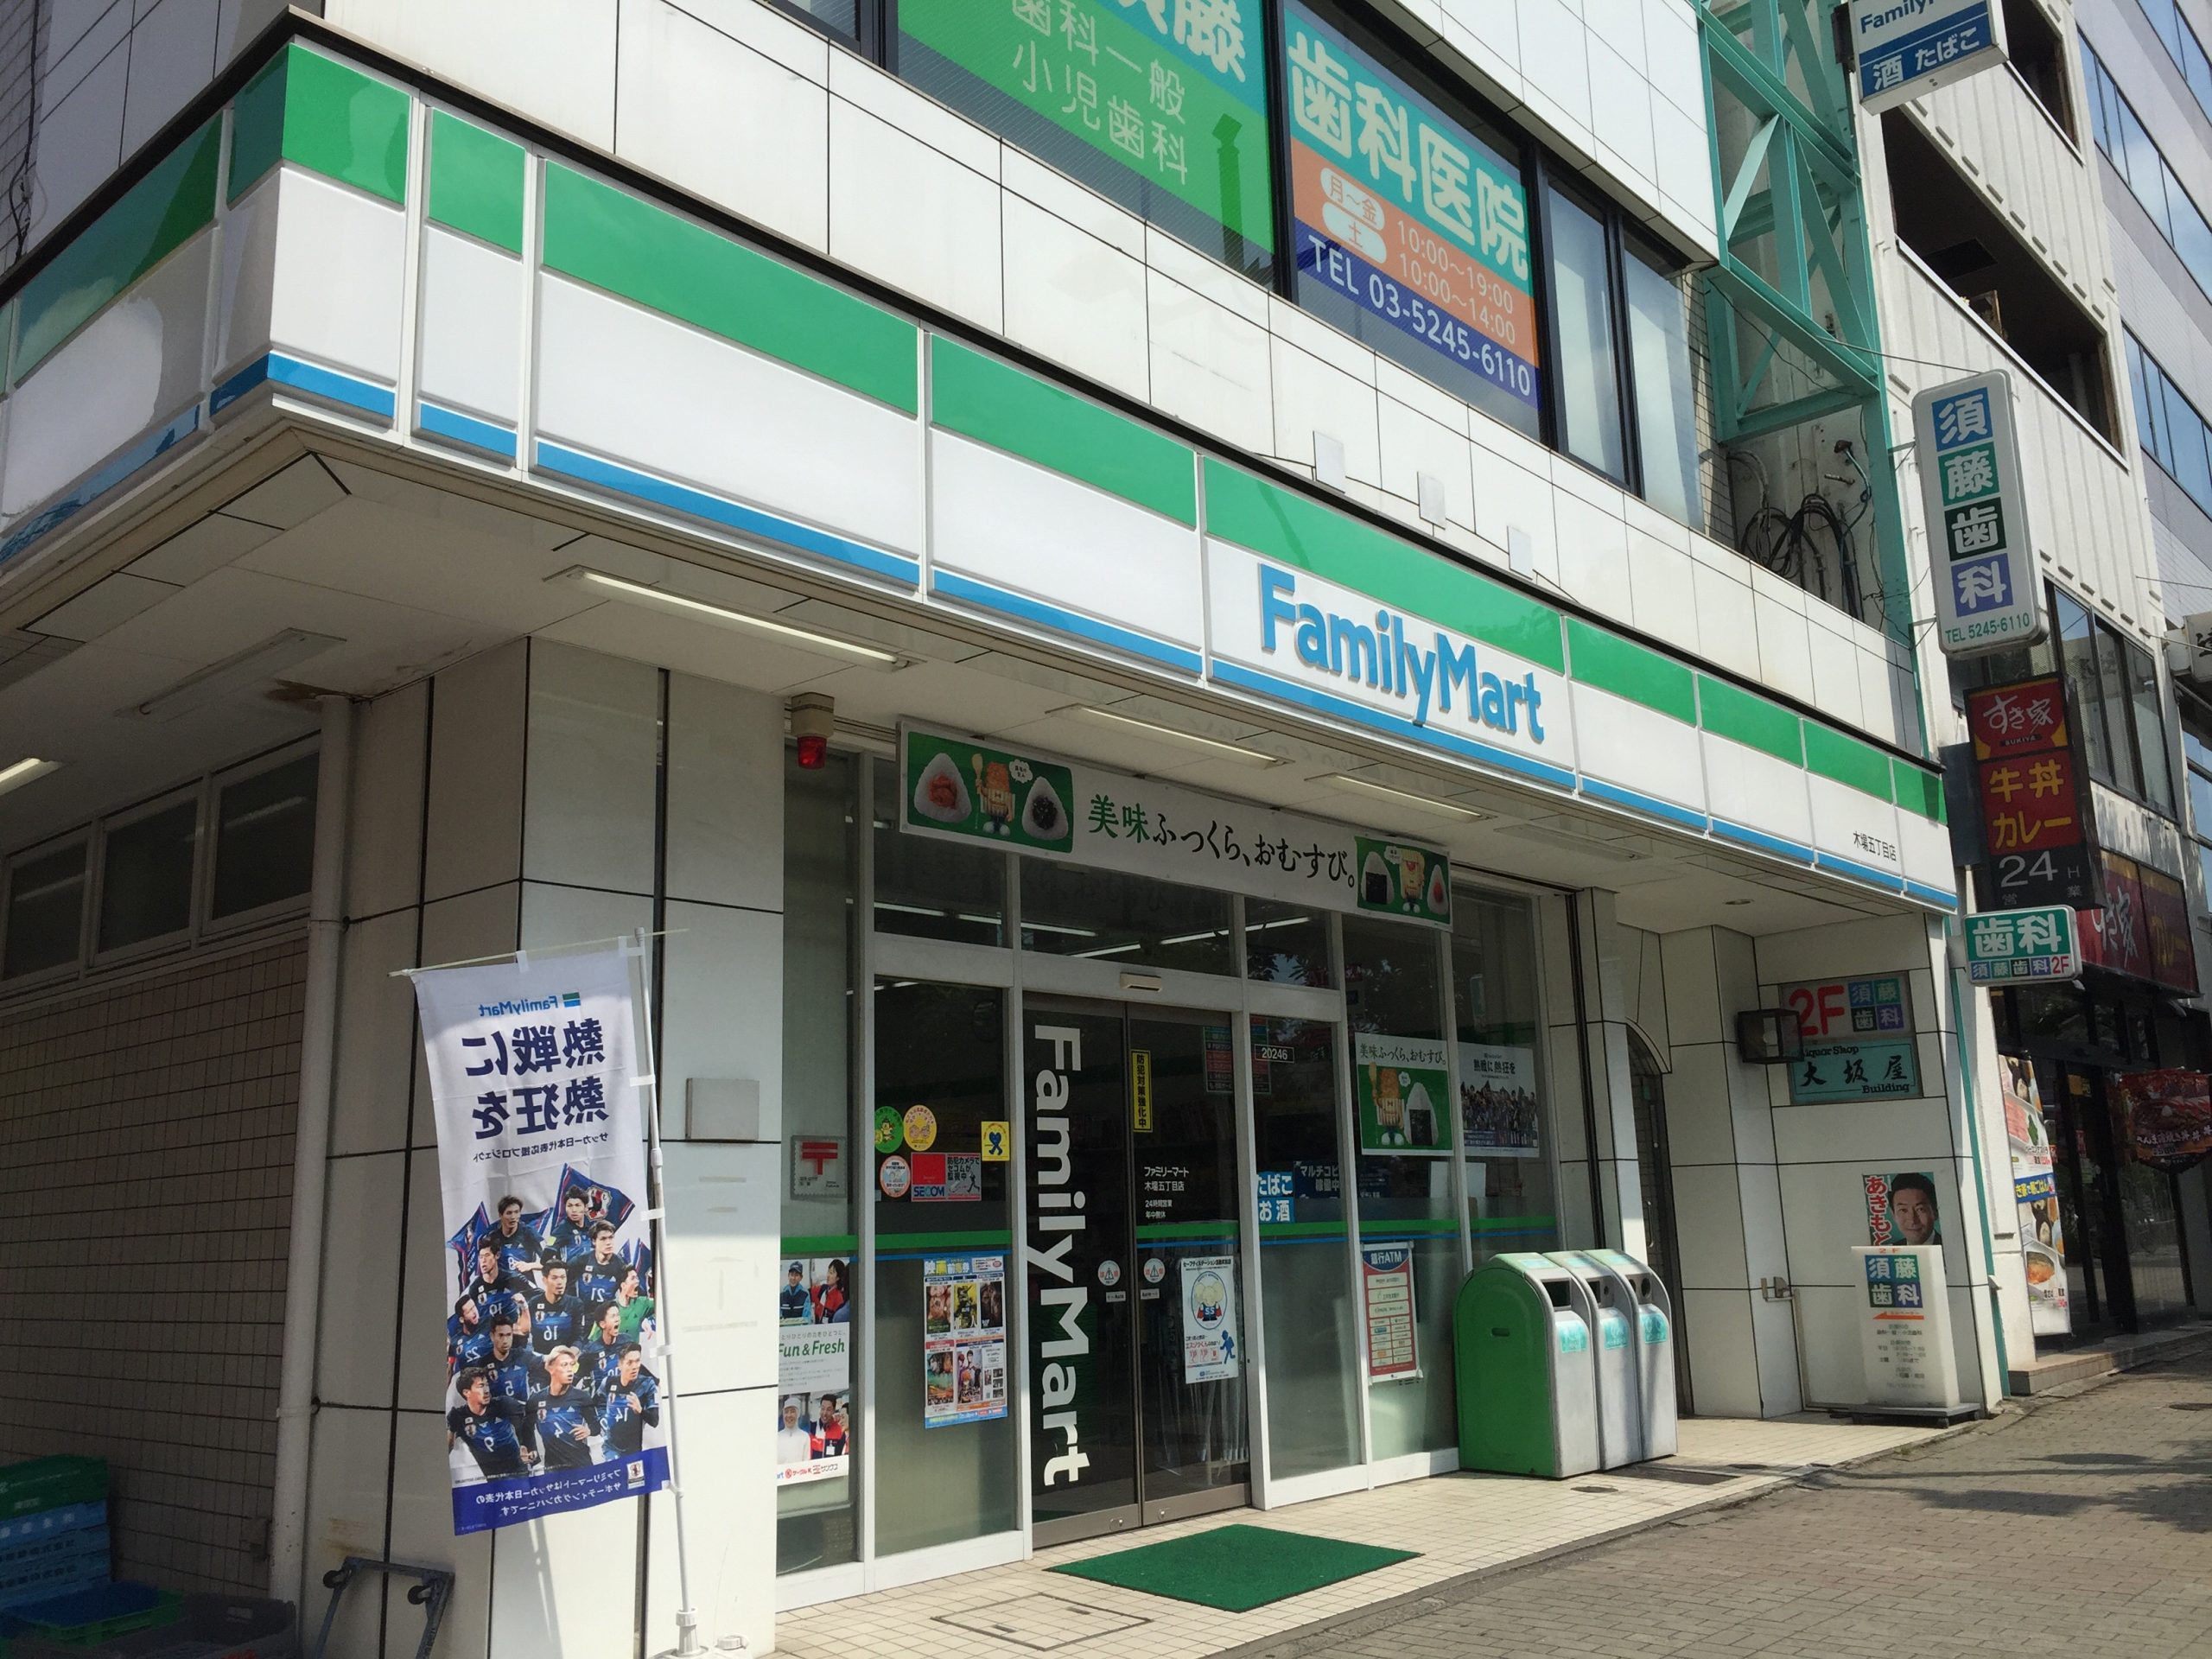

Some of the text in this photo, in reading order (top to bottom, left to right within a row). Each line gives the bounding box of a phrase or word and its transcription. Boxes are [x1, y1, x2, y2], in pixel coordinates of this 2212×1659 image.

[1872, 27, 1980, 90] 酒 たばこ
[1013, 40, 1187, 185] 小児歯科
[1288, 30, 1528, 281] 歯科医院
[1349, 221, 1363, 248] 土
[1308, 234, 1530, 397] TEL 03-5245-6110
[1939, 393, 2007, 609] 須藤歯科
[1257, 562, 1545, 745] FamilyMart
[1945, 628, 1966, 644] TEL
[1983, 695, 2054, 734] すき家
[1990, 759, 2064, 803] 牛丼
[1089, 794, 1355, 888] 美味ふっくら、おむすび。
[1993, 810, 2072, 849] カレー
[1999, 850, 2058, 887] 24
[1973, 913, 2062, 958] 歯科
[2051, 956, 2069, 975] 2F
[1789, 984, 1846, 1036] 2F
[1262, 1047, 1287, 1060] 20246
[1834, 1045, 1859, 1056] Shop
[1862, 1082, 1910, 1094] Building
[1144, 1166, 1189, 1178] ファミリーマート
[914, 1186, 944, 1197] SECOM
[1866, 1175, 1892, 1245] あきもと
[1259, 1200, 1290, 1222] お酒
[1027, 1025, 1090, 1486] FamilyMart
[1868, 1258, 1917, 1279] 須藤
[1205, 1306, 1215, 1315] SS
[1872, 1283, 1920, 1306] 歯科
[812, 1338, 845, 1355] Fresh
